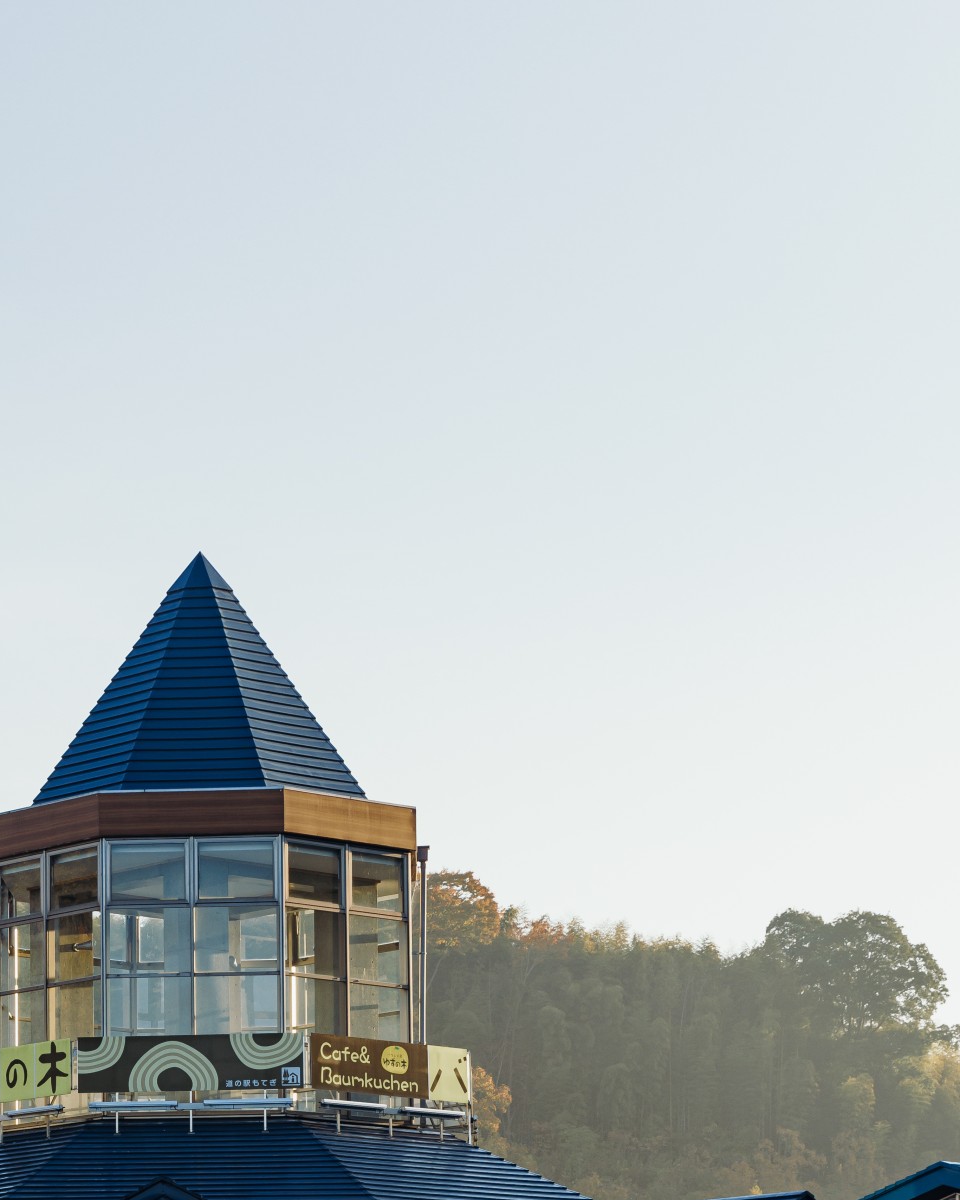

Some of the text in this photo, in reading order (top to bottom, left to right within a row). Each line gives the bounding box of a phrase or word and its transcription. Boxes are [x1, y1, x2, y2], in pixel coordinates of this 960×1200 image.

[320, 1041, 371, 1064] Cafe&
[225, 1078, 277, 1088] 道の駅もてぎ
[320, 1066, 419, 1093] Baumkuchen
[429, 1056, 468, 1094] バ
